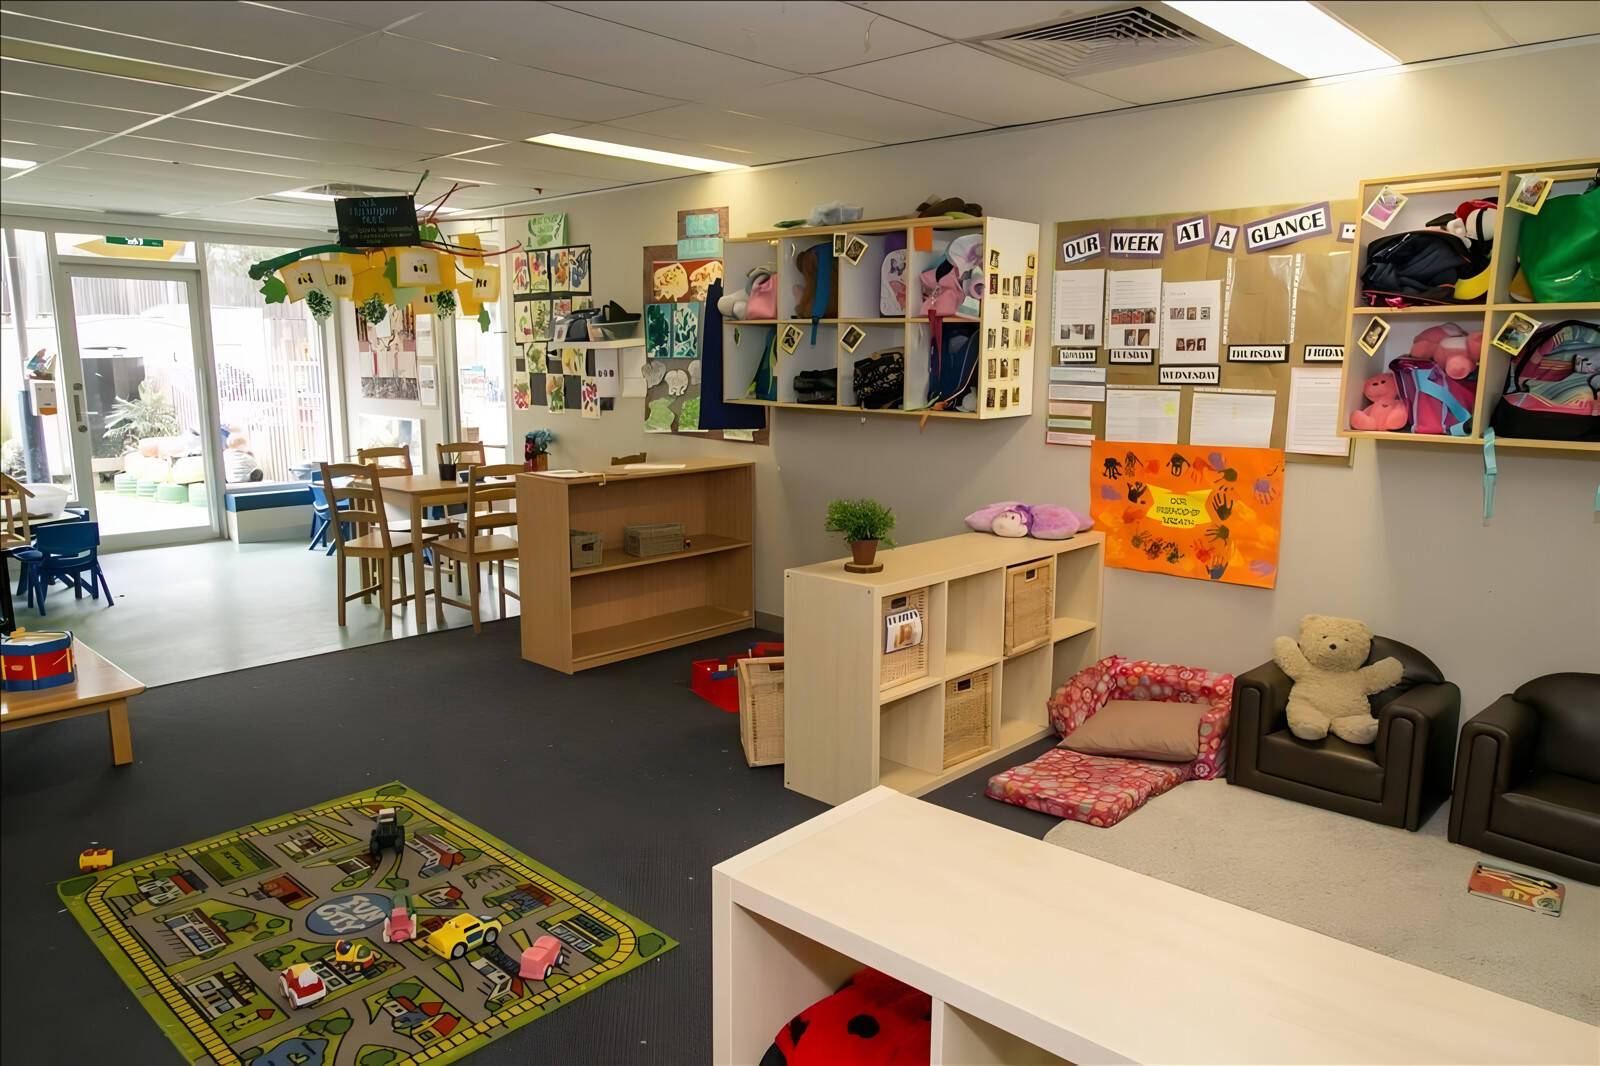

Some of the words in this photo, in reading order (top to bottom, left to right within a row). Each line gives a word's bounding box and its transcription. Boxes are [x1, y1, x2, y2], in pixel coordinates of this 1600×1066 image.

[1065, 236, 1098, 258] OUR
[1113, 235, 1159, 251] WEEK
[1179, 222, 1201, 242] AT
[1218, 230, 1230, 246] A
[1251, 211, 1324, 244] GLANCE
[1113, 350, 1149, 359] TUESDAY
[1232, 349, 1283, 358] THURSDAY
[1162, 371, 1215, 380] WEDNESDAY
[339, 894, 387, 922] FUN
[315, 904, 366, 933] CITY
